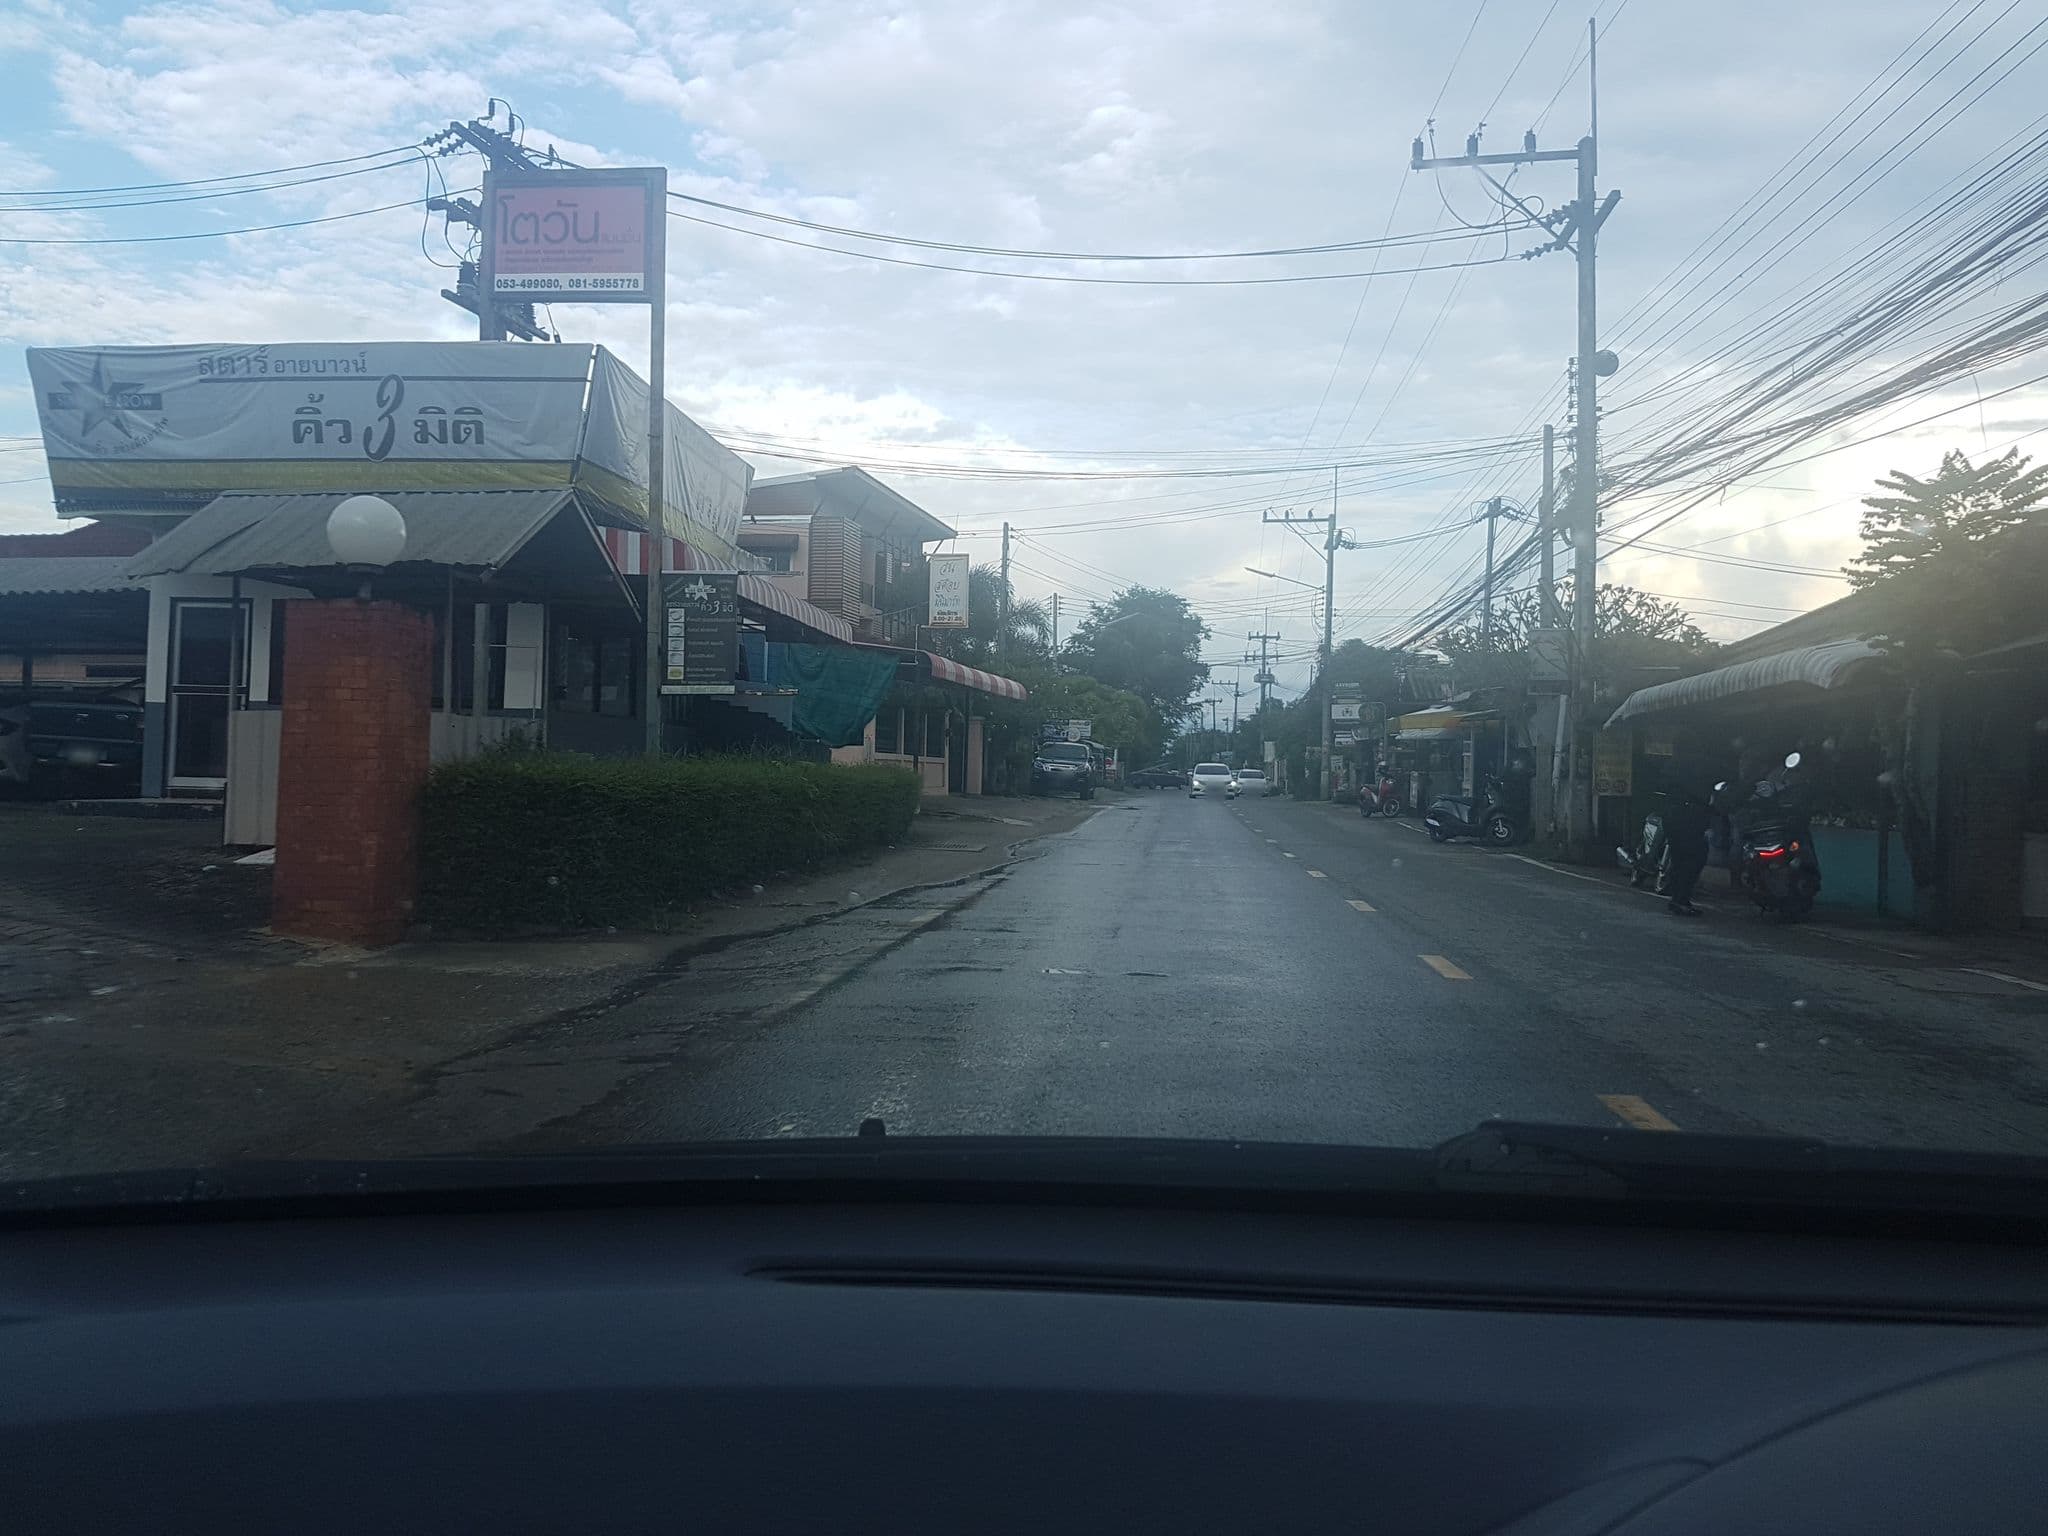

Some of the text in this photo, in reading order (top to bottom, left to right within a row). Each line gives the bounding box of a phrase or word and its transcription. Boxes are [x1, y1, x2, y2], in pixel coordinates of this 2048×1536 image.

[498, 194, 600, 244] โตวัน
[568, 278, 639, 289] 081-5955778
[199, 344, 369, 375] สตาร์ อายบาวน์
[291, 373, 485, 461] คิ้ว 3 มิติ
